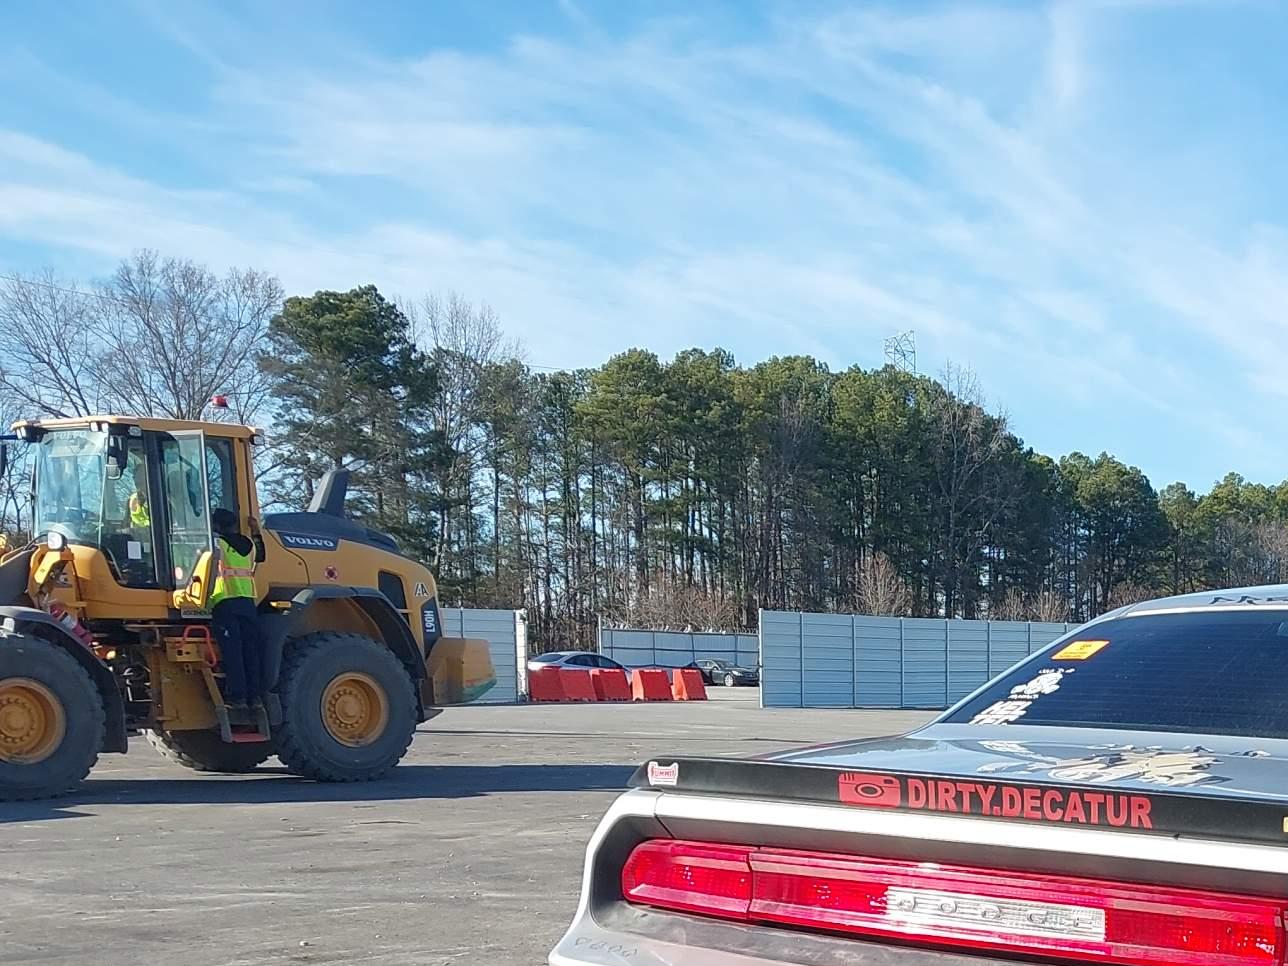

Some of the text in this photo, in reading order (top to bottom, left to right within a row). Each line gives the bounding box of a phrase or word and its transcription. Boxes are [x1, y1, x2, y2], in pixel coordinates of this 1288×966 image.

[284, 535, 335, 548] VOLVO
[423, 610, 436, 633] L90H
[907, 778, 1153, 830] DIRTY.DECATUR
